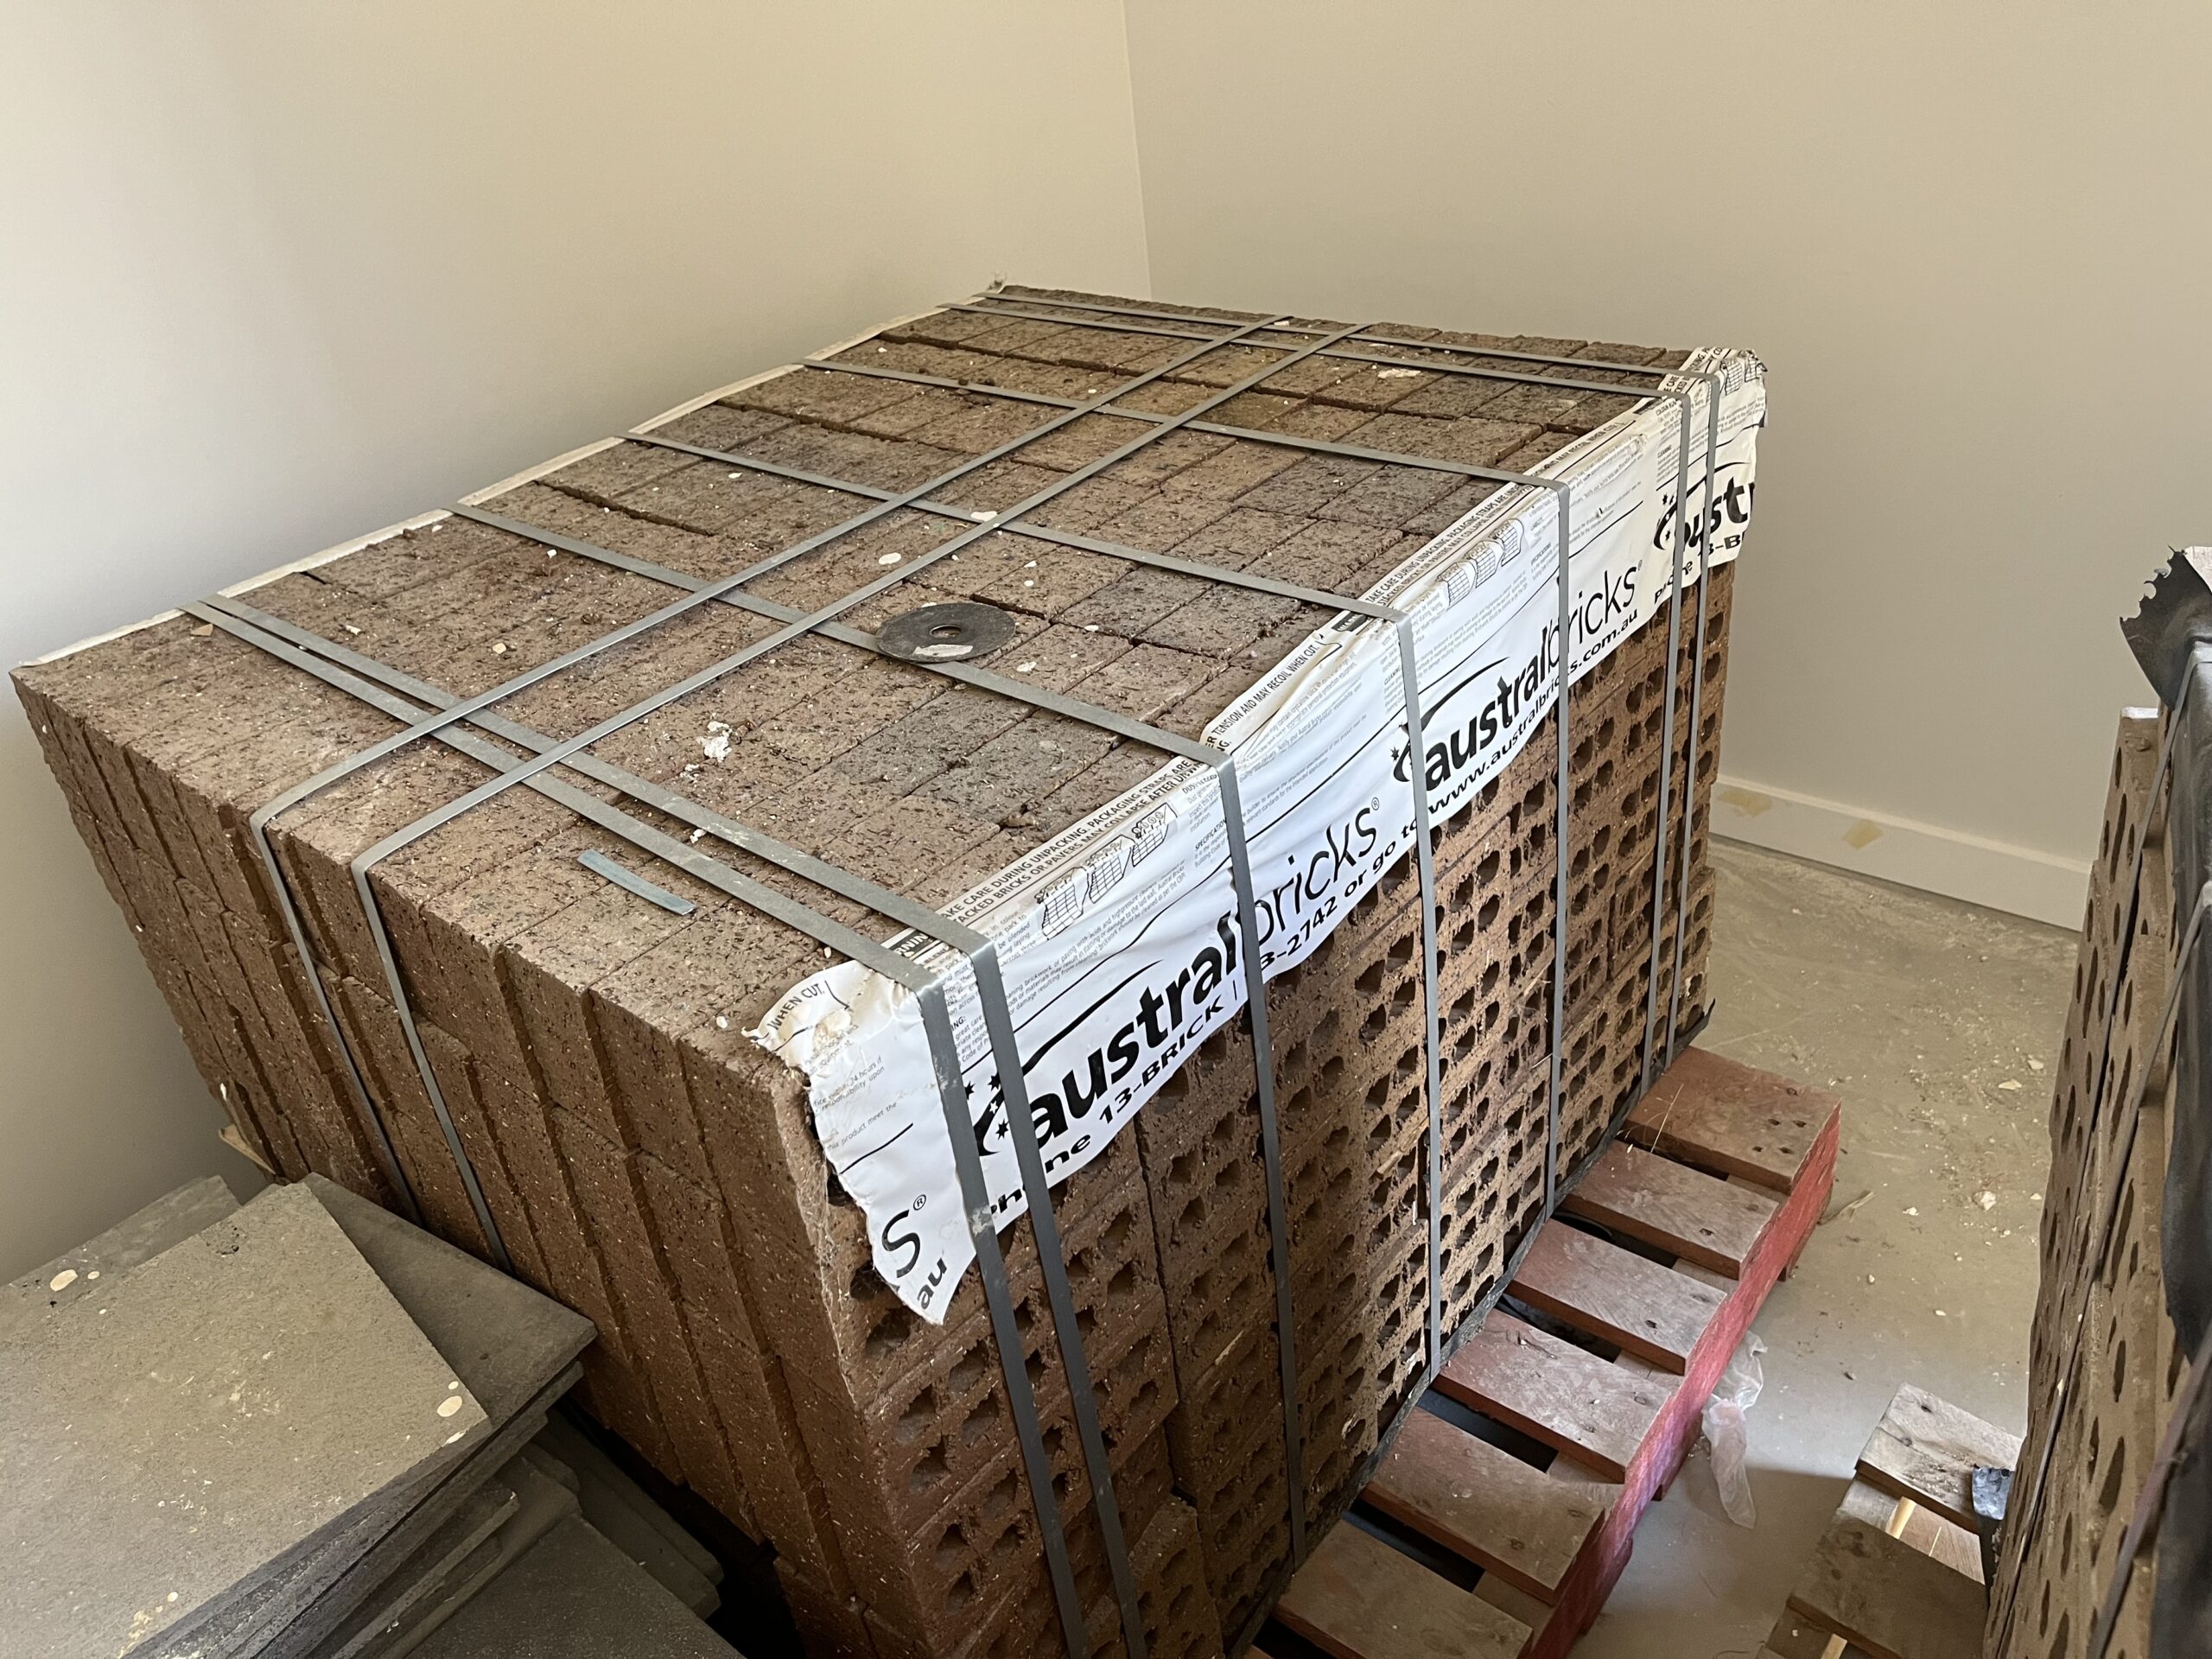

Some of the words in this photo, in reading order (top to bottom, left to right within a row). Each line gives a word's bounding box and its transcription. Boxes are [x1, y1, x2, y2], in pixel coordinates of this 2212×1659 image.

[942, 904, 964, 920] AKE
[963, 887, 992, 904] CARE
[992, 861, 1031, 887] DURING
[1030, 828, 1086, 861] UNPACKING.
[1088, 793, 1140, 827] PACKAGING
[1172, 758, 1191, 773] ARE
[1211, 710, 1243, 739] TENSION
[1240, 699, 1256, 714] AND
[1253, 687, 1270, 702] MAY
[1267, 671, 1291, 690] RECOIL
[1287, 655, 1307, 674] WHEN
[1303, 644, 1319, 656] CUT.
[957, 898, 993, 924] ACKED
[995, 874, 1031, 898] BRICKS
[1030, 864, 1045, 874] OR
[1045, 842, 1083, 865] PAVERS
[1148, 780, 1175, 800] AFTER
[1003, 984, 1023, 999] eaning
[1024, 965, 1052, 985] brickwork
[1060, 945, 1077, 963] paving
[1103, 917, 1111, 928] and
[1025, 974, 1051, 993] materials
[1062, 955, 1077, 968] result
[1106, 916, 1125, 932] damage
[1138, 896, 1147, 906] laid
[767, 996, 803, 1030] WHEN
[1016, 991, 1036, 1009] damage
[1036, 974, 1059, 992] resulting
[970, 1014, 983, 1025] care
[991, 1135, 1090, 1215] hne
[1099, 994, 1224, 1124] 13-BRICK
[1261, 896, 1338, 972] 3-2742
[1344, 869, 1367, 898] or
[1372, 841, 1396, 874] go
[868, 1066, 886, 1082] upon
[962, 1048, 977, 1062] Code
[840, 1122, 868, 1150] product
[868, 1109, 885, 1126] meet
[885, 1101, 898, 1113] the
